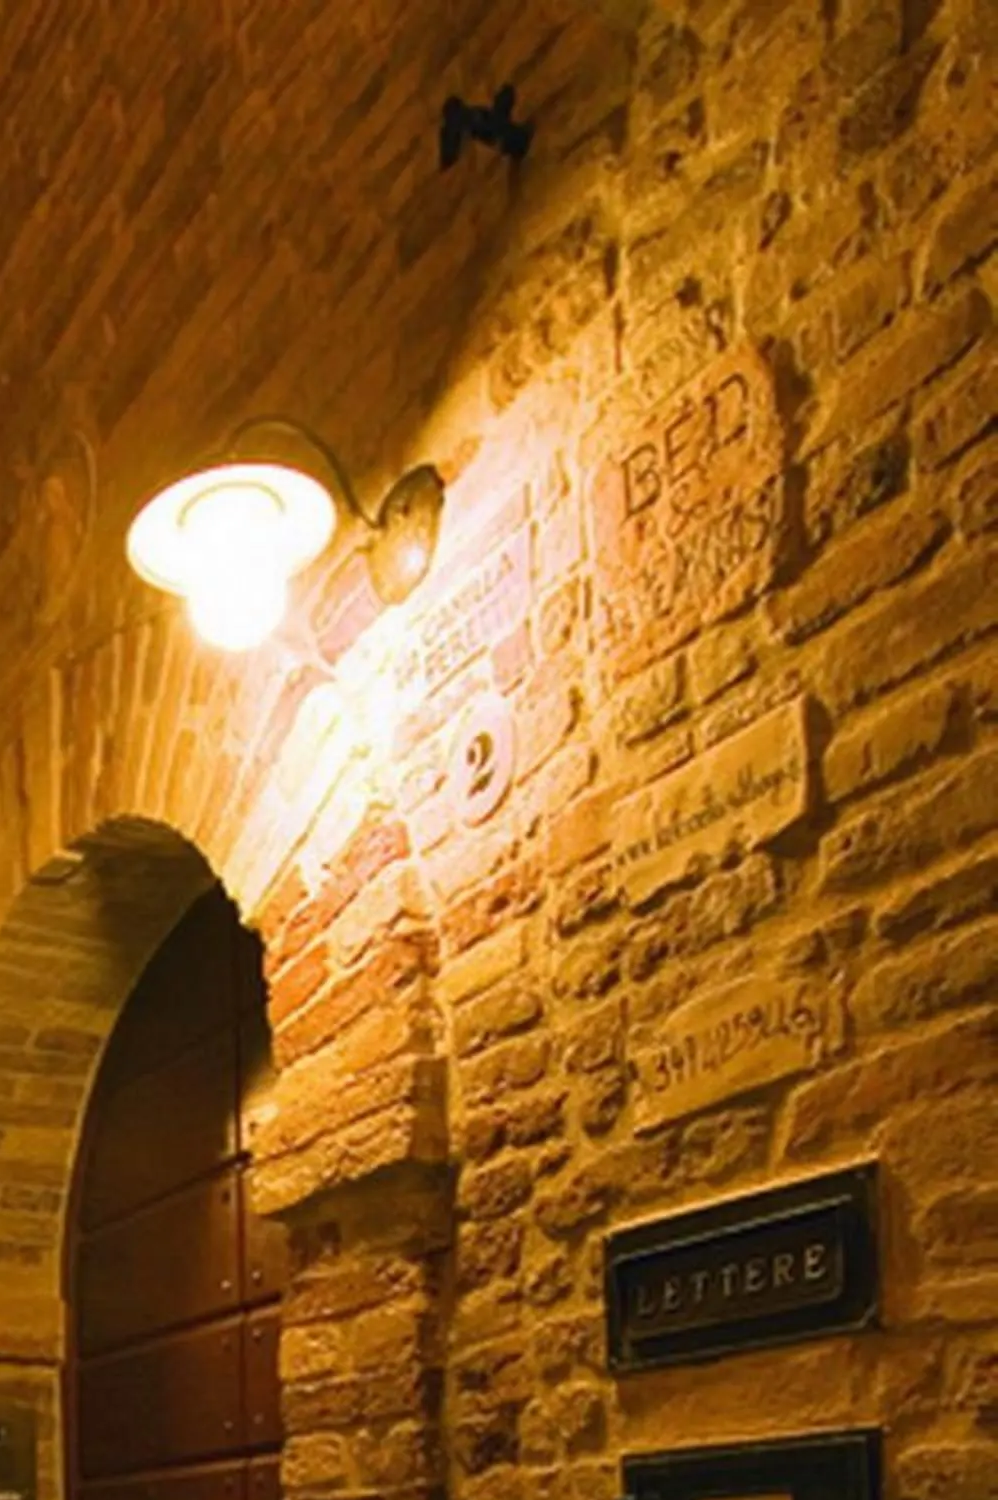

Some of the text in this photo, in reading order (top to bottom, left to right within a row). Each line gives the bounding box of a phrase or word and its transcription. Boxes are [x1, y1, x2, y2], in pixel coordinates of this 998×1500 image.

[620, 373, 749, 521] BED
[465, 730, 494, 800] 2
[637, 1243, 827, 1317] LETTERE
